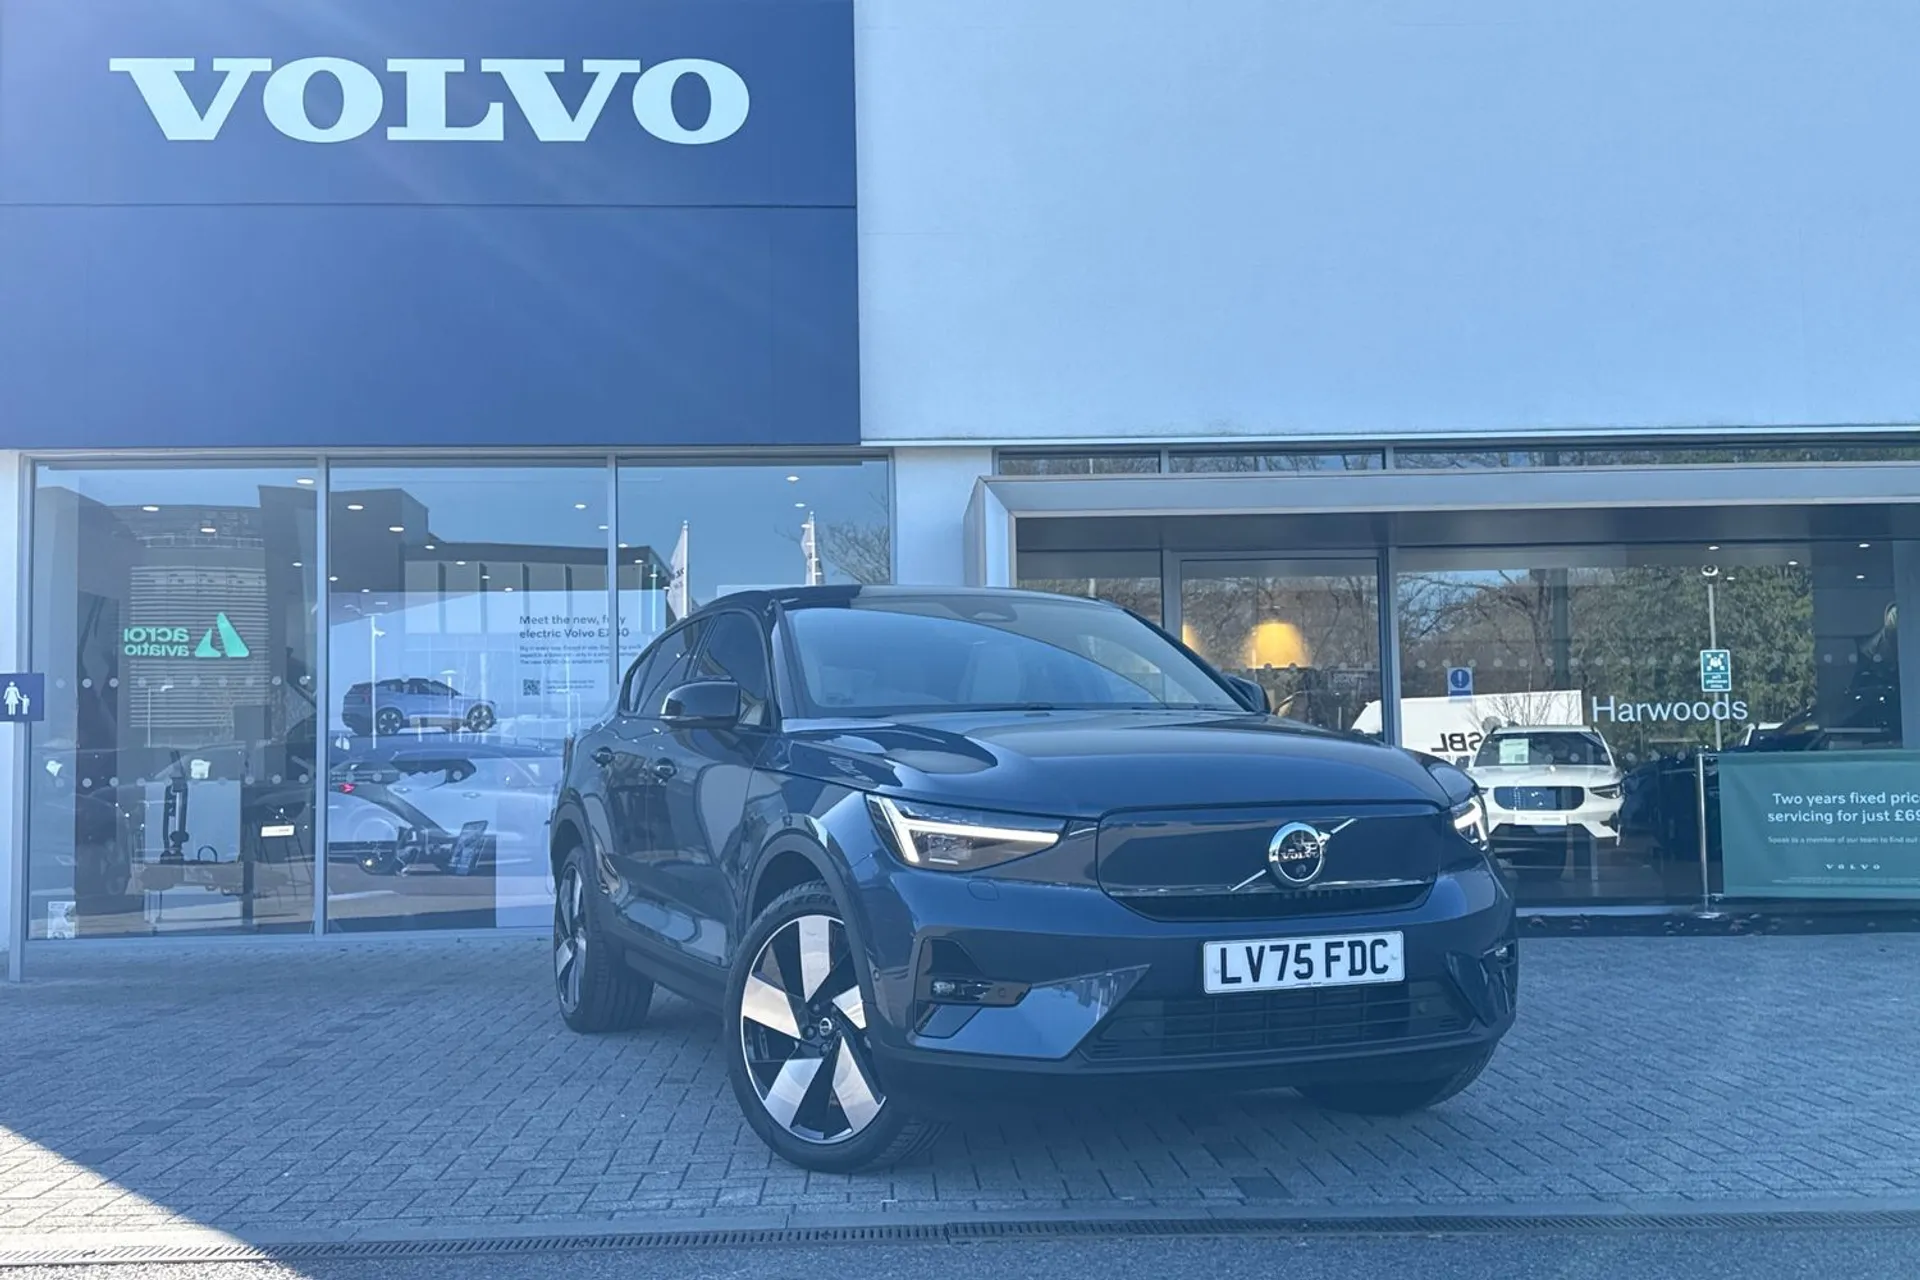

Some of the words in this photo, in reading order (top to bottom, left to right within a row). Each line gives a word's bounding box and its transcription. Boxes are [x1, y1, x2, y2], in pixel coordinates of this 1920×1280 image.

[109, 56, 750, 144] VOLVO
[519, 615, 549, 625] Meet
[551, 614, 571, 625] the
[573, 616, 600, 626] new,
[519, 629, 561, 639] electric
[564, 628, 595, 638] Volvo
[1592, 693, 1748, 722] Harwoods
[1772, 792, 1803, 805] Two
[1806, 794, 1846, 807] years
[1850, 791, 1886, 804] fixed
[1767, 810, 1833, 824] servicing
[1837, 809, 1858, 822] for
[1861, 809, 1891, 824] just
[1219, 943, 1314, 985] LV75
[1324, 938, 1390, 979] FDC
